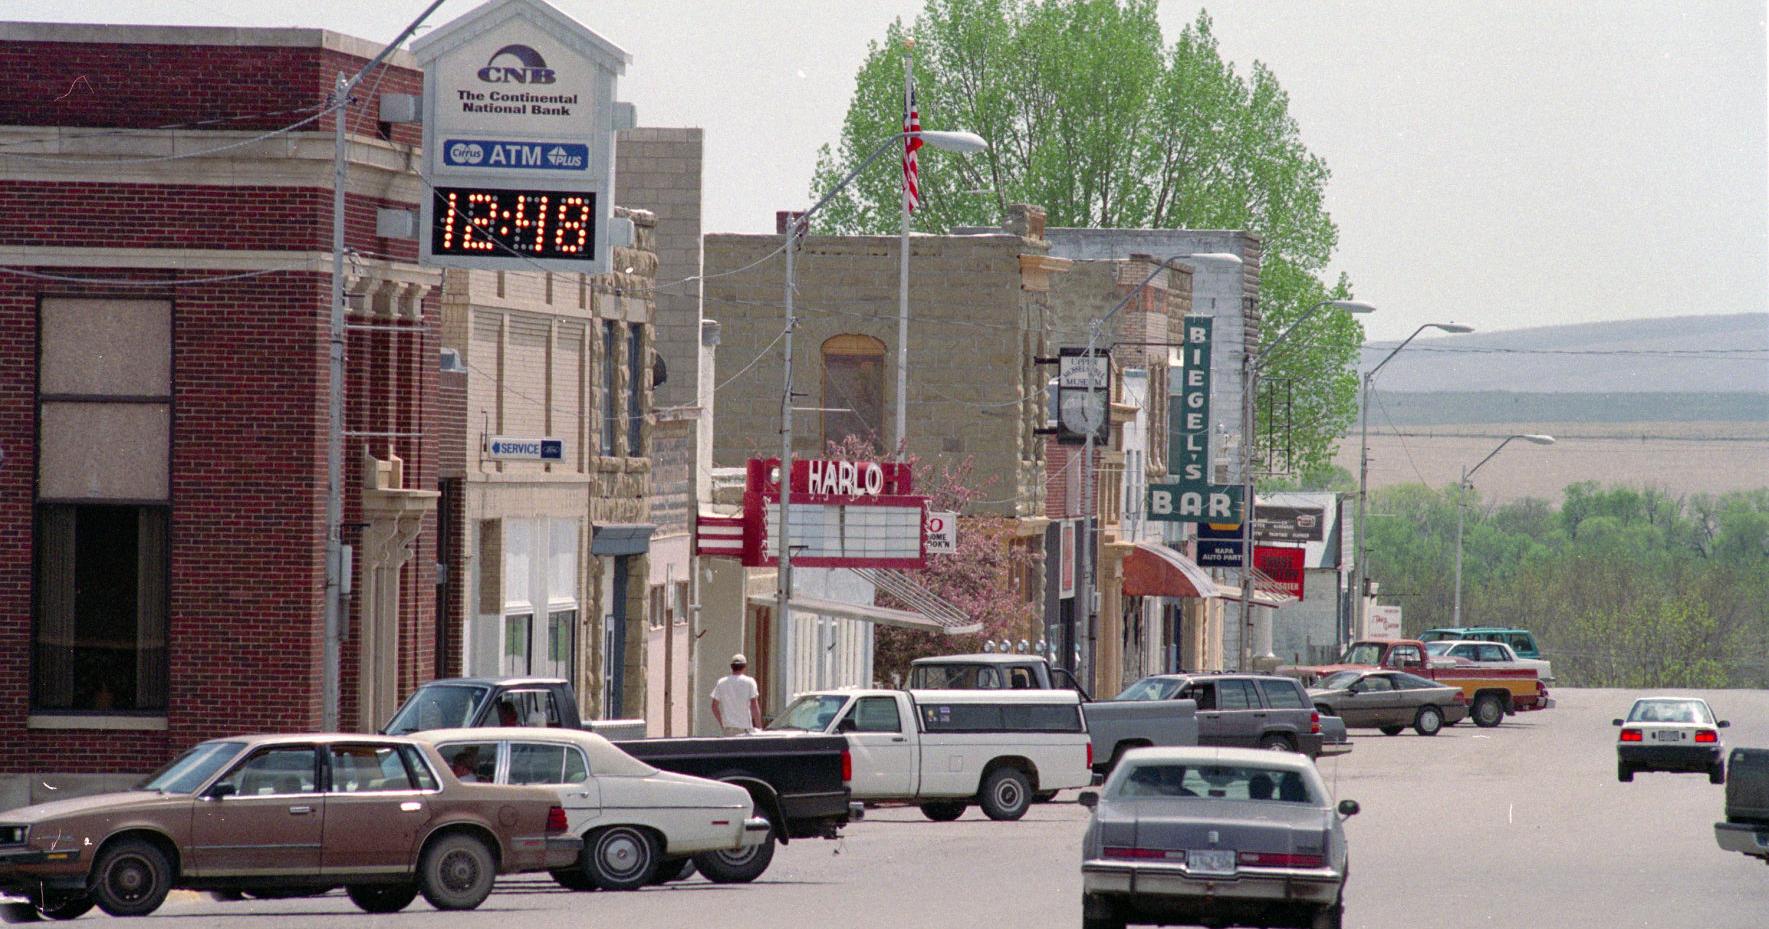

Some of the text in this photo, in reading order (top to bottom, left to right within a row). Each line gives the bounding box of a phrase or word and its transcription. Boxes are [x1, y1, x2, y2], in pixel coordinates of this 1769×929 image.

[477, 66, 557, 84] CNB
[457, 90, 578, 104] The Continental
[462, 102, 571, 116] National Bank
[452, 145, 582, 166] Cirrus ATM PLUS
[443, 192, 590, 253] 12:48
[1184, 327, 1206, 480] BIEGEL'S
[501, 443, 540, 454] SERVICE
[808, 460, 883, 494] HARLO
[1152, 490, 1231, 518] BAR
[928, 533, 948, 541] OME
[1202, 553, 1222, 561] AUTO
